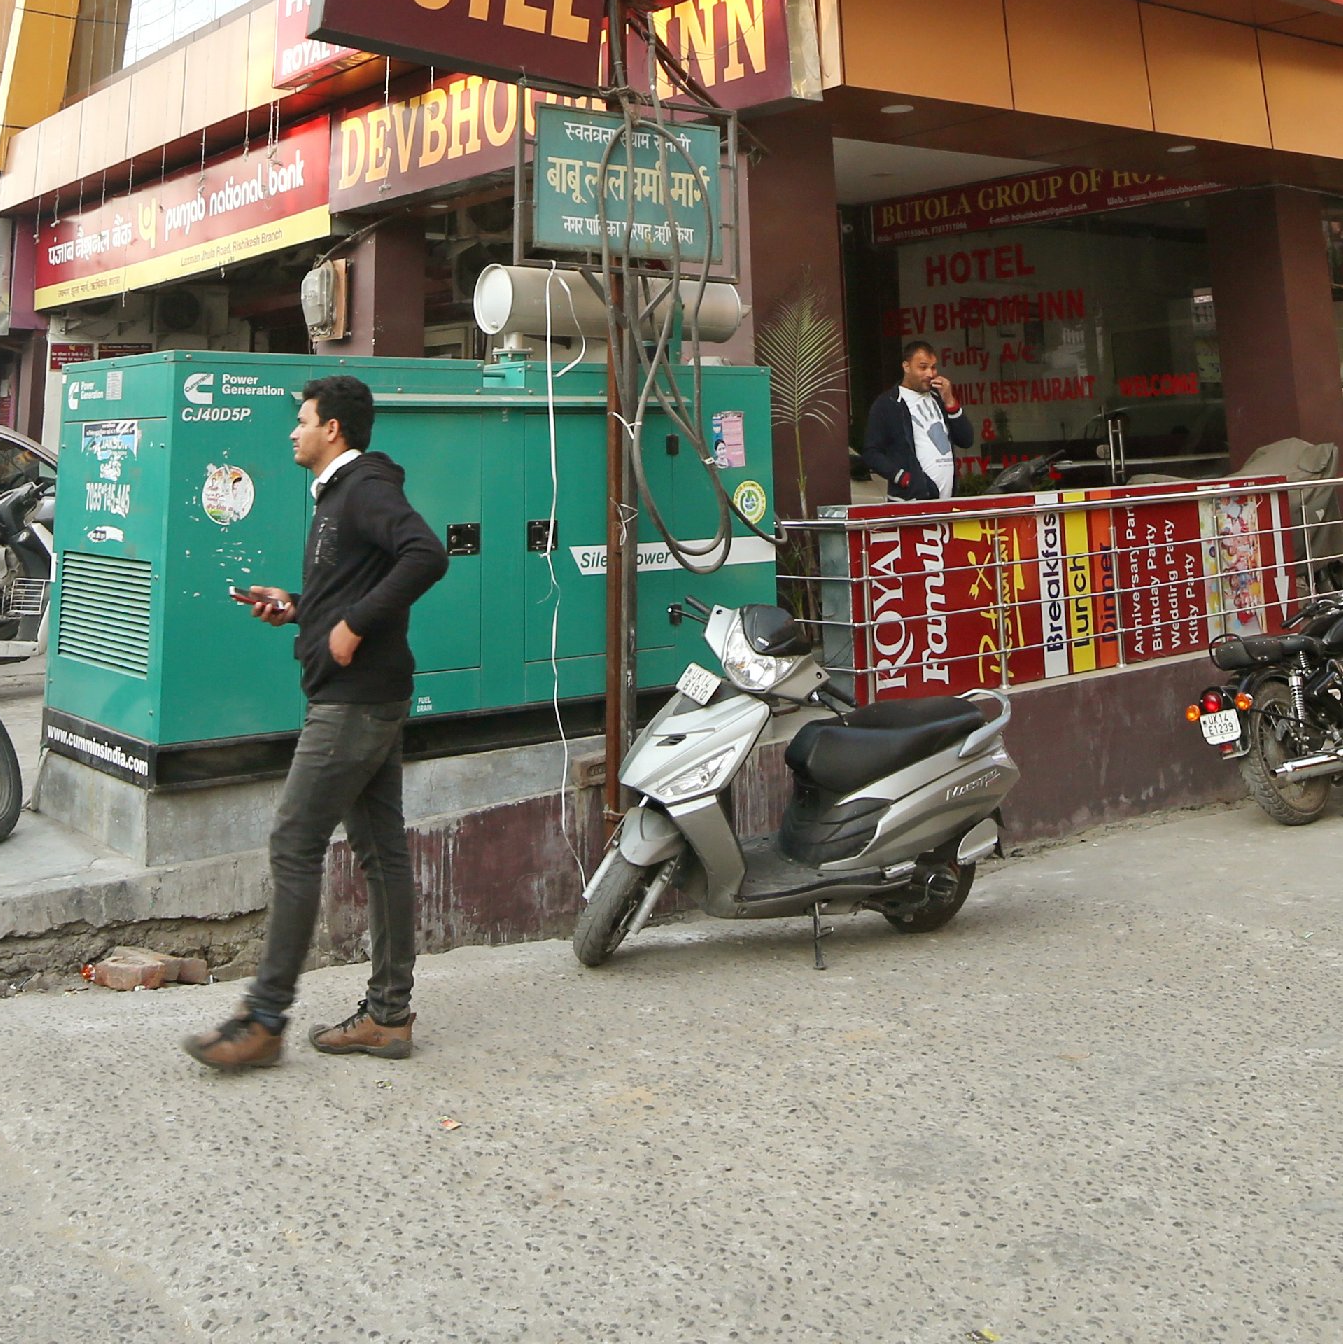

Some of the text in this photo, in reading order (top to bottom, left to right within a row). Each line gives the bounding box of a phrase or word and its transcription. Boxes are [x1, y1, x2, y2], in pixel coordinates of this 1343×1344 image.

[281, 39, 330, 76] ROYAL
[164, 149, 304, 241] punjab national bank
[547, 156, 588, 204] बाबू
[882, 192, 972, 227] BUTOLA
[978, 175, 1063, 211] GROUP
[1069, 167, 1104, 196] OF
[232, 233, 261, 253] Rishikesh
[261, 227, 283, 244] Branch
[562, 215, 584, 236] नगर
[48, 236, 74, 266] पंजाब
[925, 243, 1035, 287] HOTEL
[883, 305, 927, 337] DEV
[1037, 288, 1086, 321] INN
[81, 381, 95, 391] Power
[222, 373, 259, 385] Power
[222, 384, 285, 397] Generation
[955, 375, 1097, 406] MILY RESTAURANT
[1119, 371, 1200, 398] WELCOME
[181, 408, 251, 422] CJ40D5P
[981, 418, 997, 440] &
[956, 455, 991, 479] RTY
[579, 549, 673, 569] Sile ower
[1042, 512, 1064, 653] Breakfas
[1145, 523, 1164, 651] Birthday Party
[1164, 519, 1182, 649] Wedding Party
[1185, 553, 1197, 600] Party
[869, 525, 914, 694] ROYAL
[1069, 552, 1091, 648] Lunch
[1126, 546, 1145, 654] Anniversary
[1208, 712, 1230, 725] UK14
[1209, 722, 1235, 735] E1239
